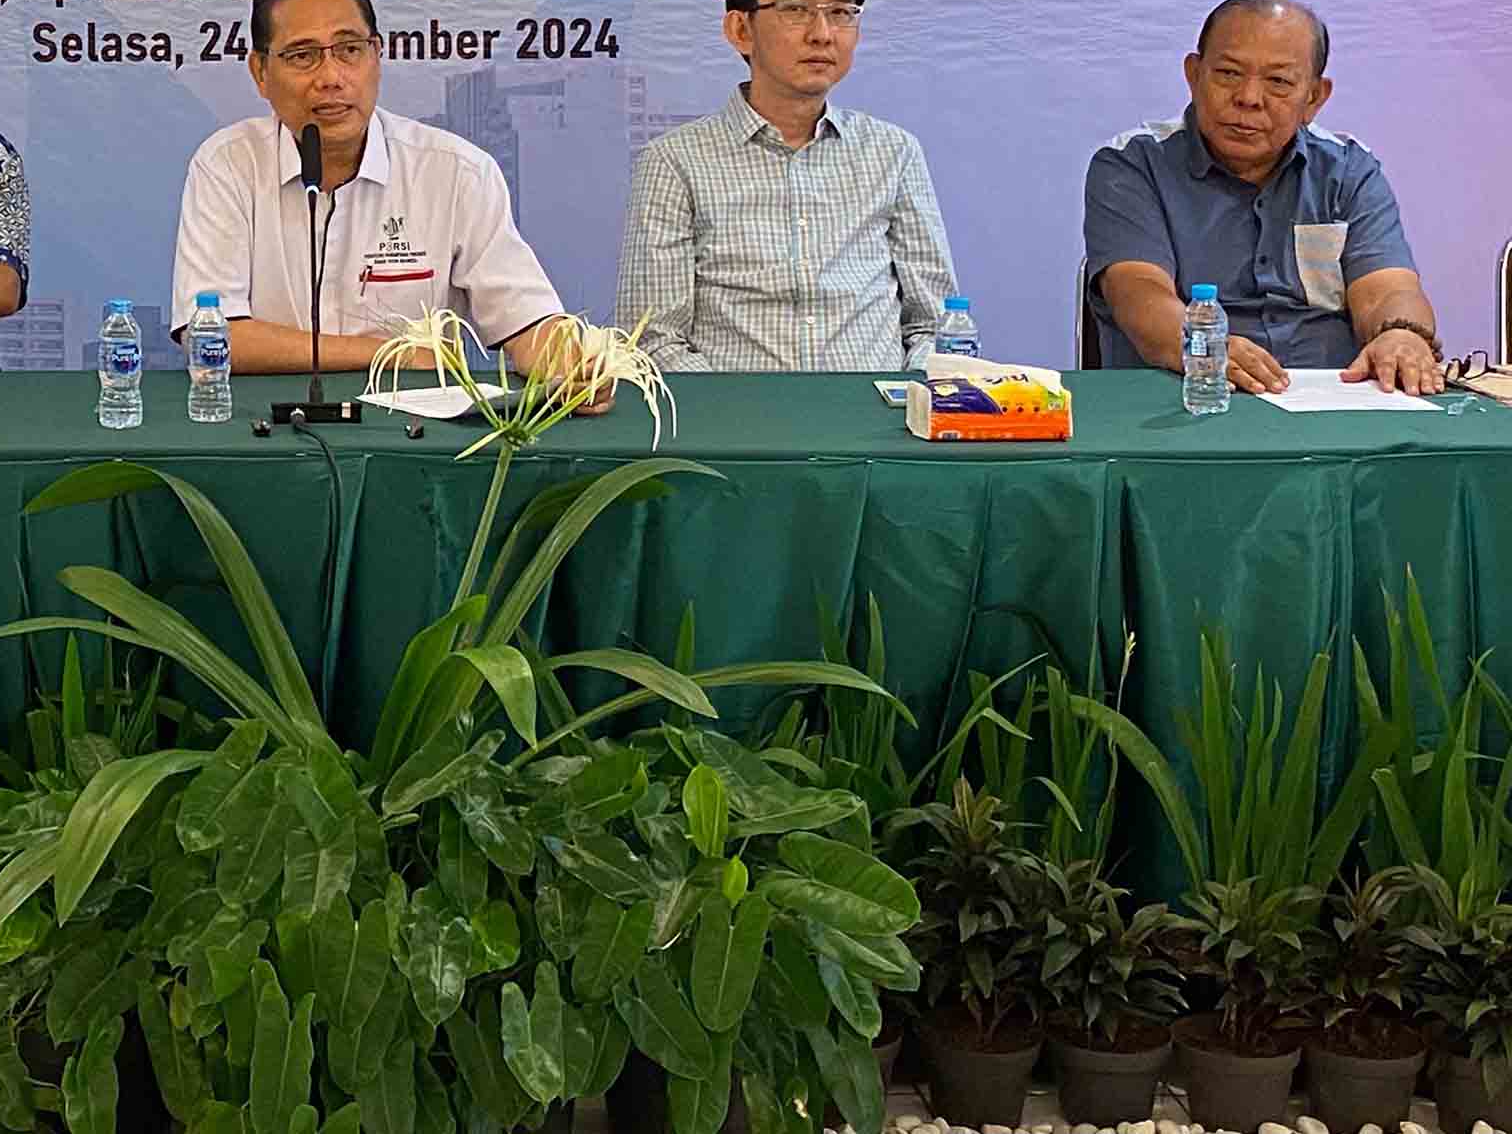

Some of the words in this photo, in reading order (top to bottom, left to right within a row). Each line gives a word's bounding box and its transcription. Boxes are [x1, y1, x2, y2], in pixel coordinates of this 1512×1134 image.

[32, 22, 184, 71] Selasa,
[199, 20, 249, 63] 24
[516, 17, 620, 60] 2024
[379, 242, 411, 251] P3RSI
